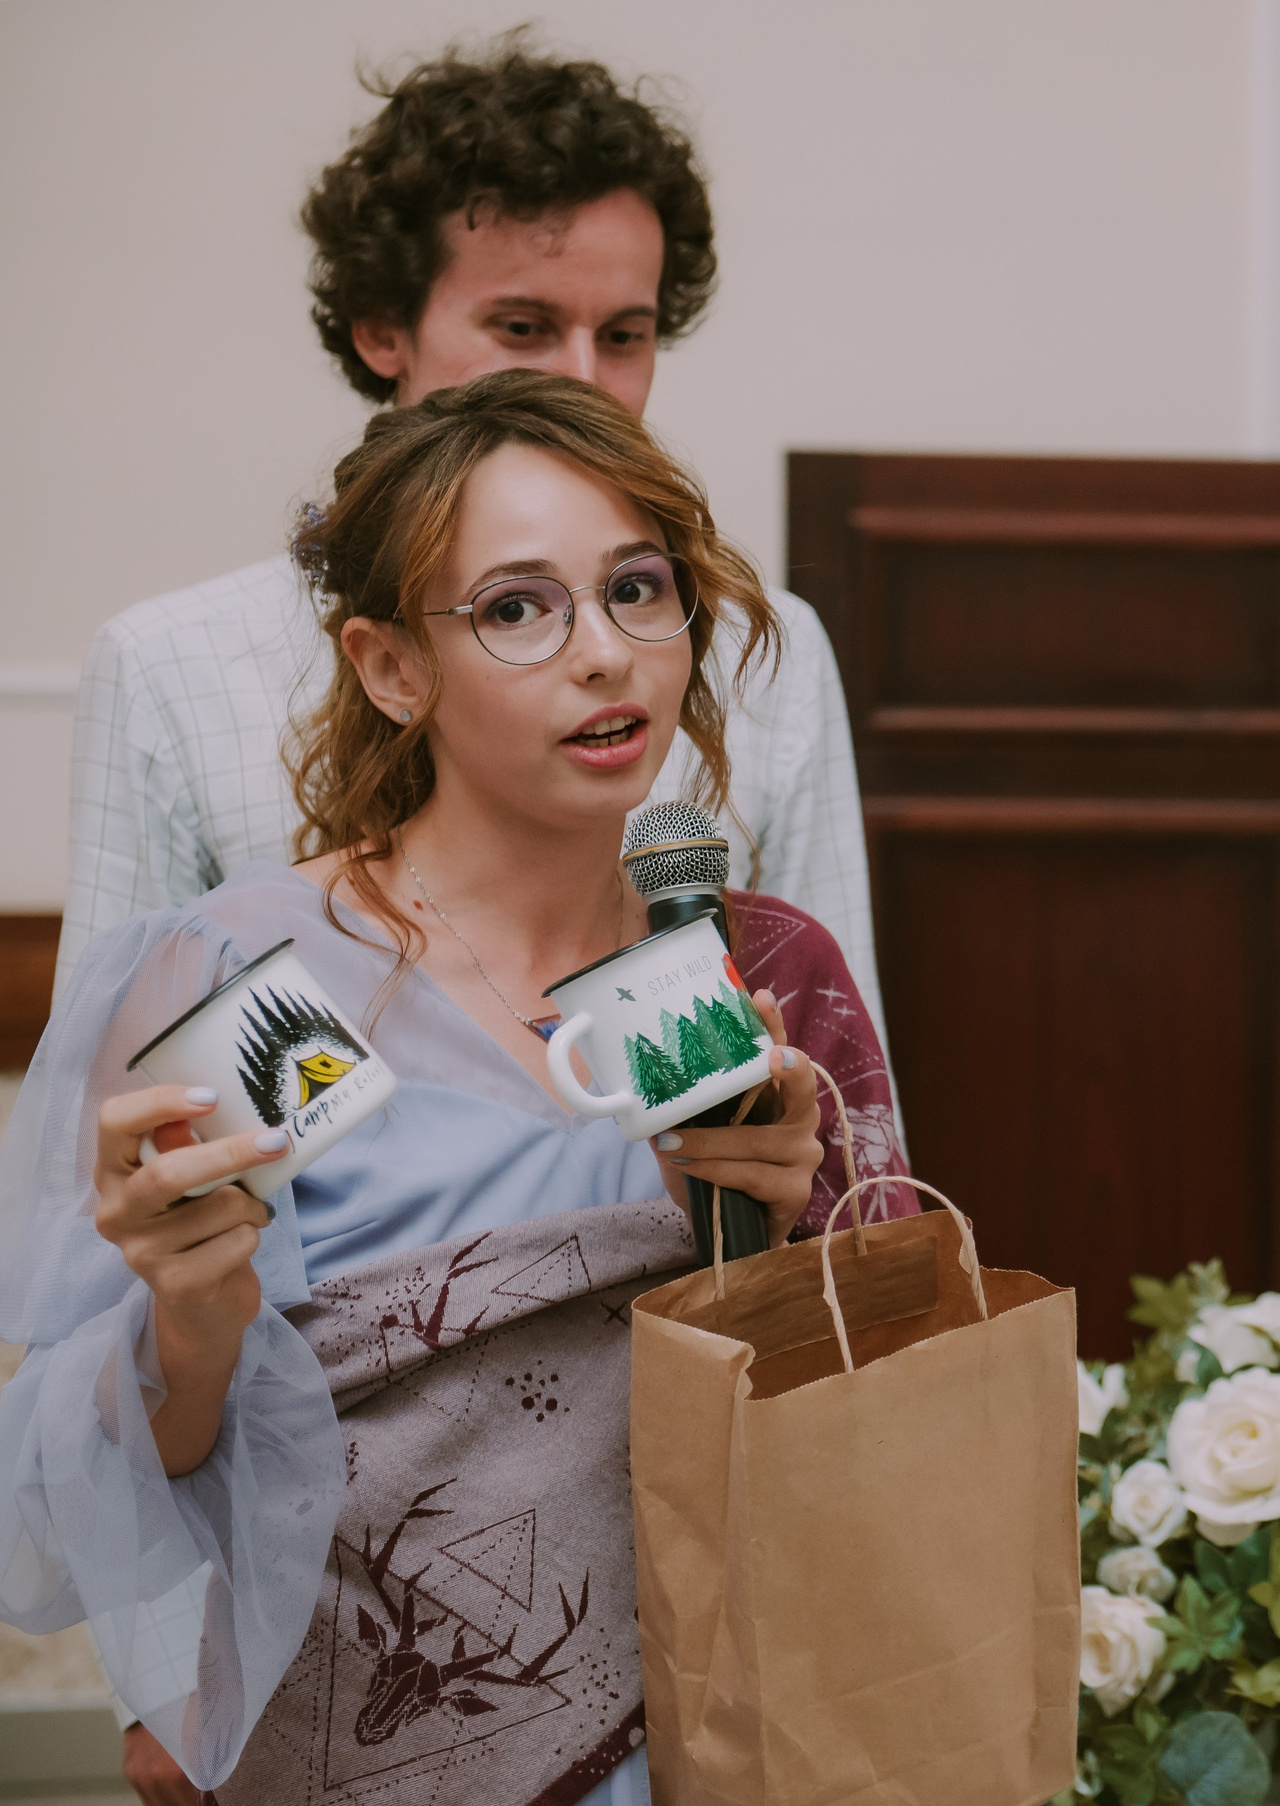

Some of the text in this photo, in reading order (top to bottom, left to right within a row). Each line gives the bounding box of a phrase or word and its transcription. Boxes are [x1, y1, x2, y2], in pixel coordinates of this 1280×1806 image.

[647, 955, 712, 996] STAY WILD
[293, 1100, 332, 1138] Camp
